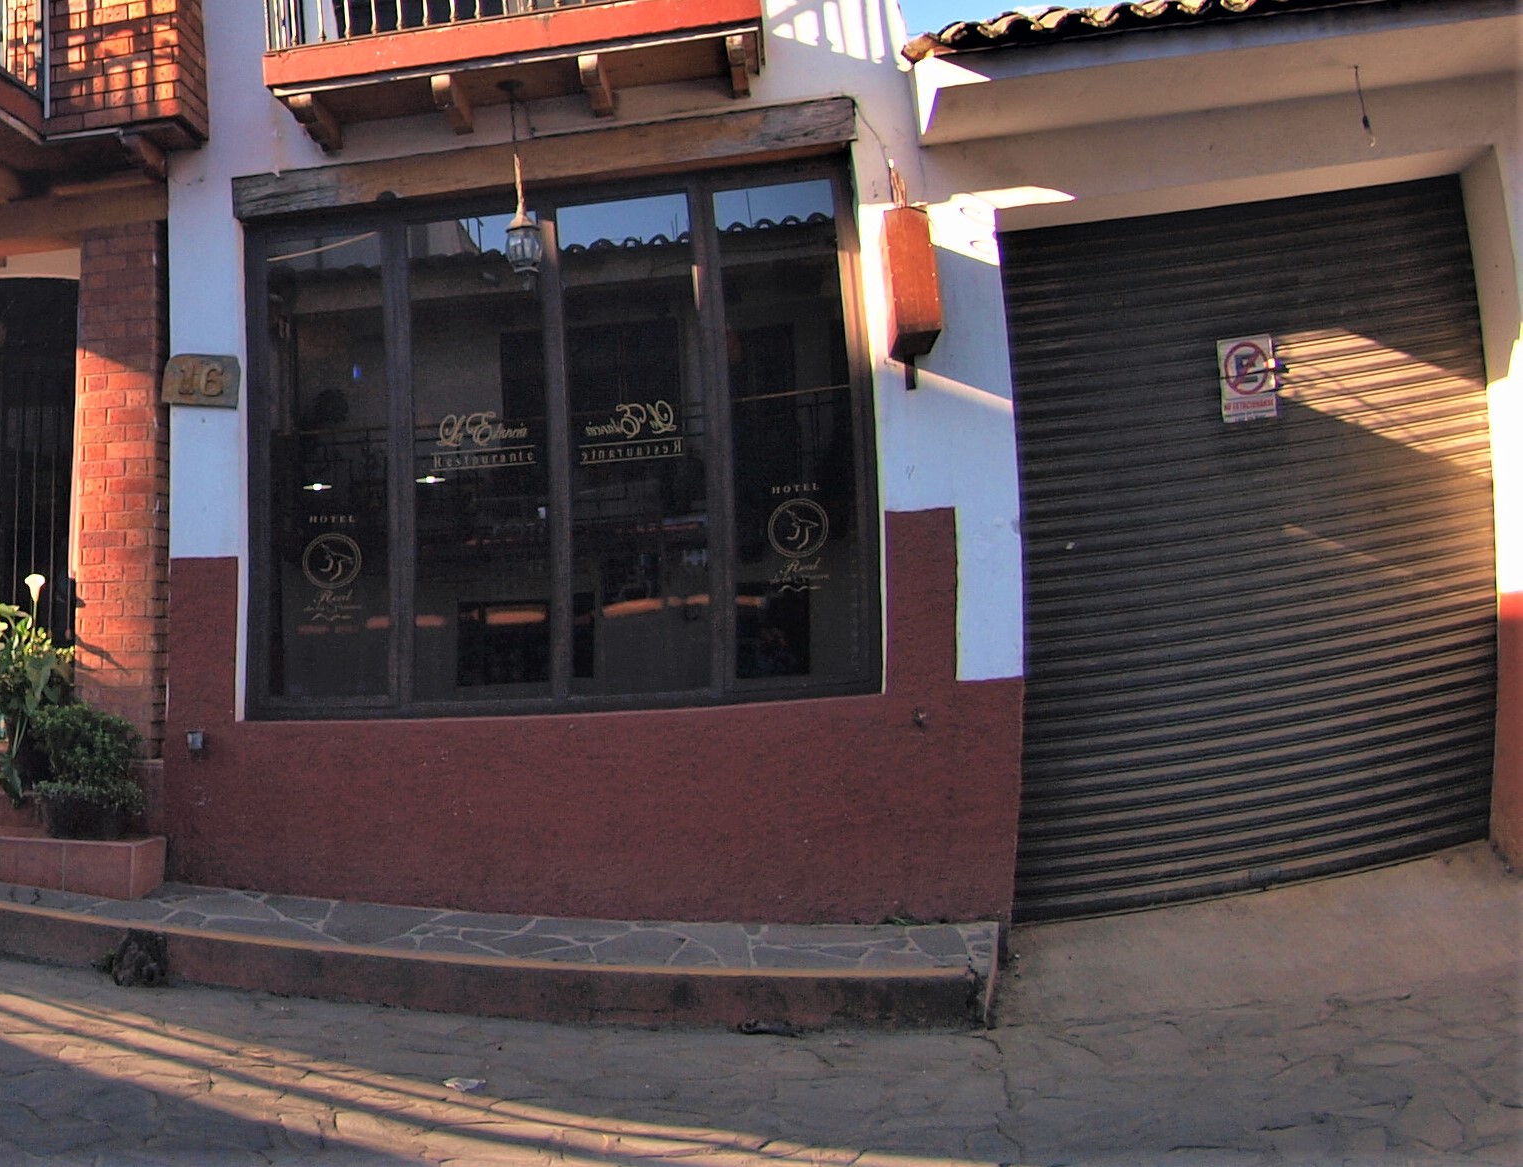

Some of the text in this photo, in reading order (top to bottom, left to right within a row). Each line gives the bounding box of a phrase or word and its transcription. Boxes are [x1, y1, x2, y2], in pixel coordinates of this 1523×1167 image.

[179, 365, 224, 398] 16
[434, 451, 534, 468] Restaurante
[772, 482, 819, 495] HOTEL
[309, 515, 355, 524] HOTEL
